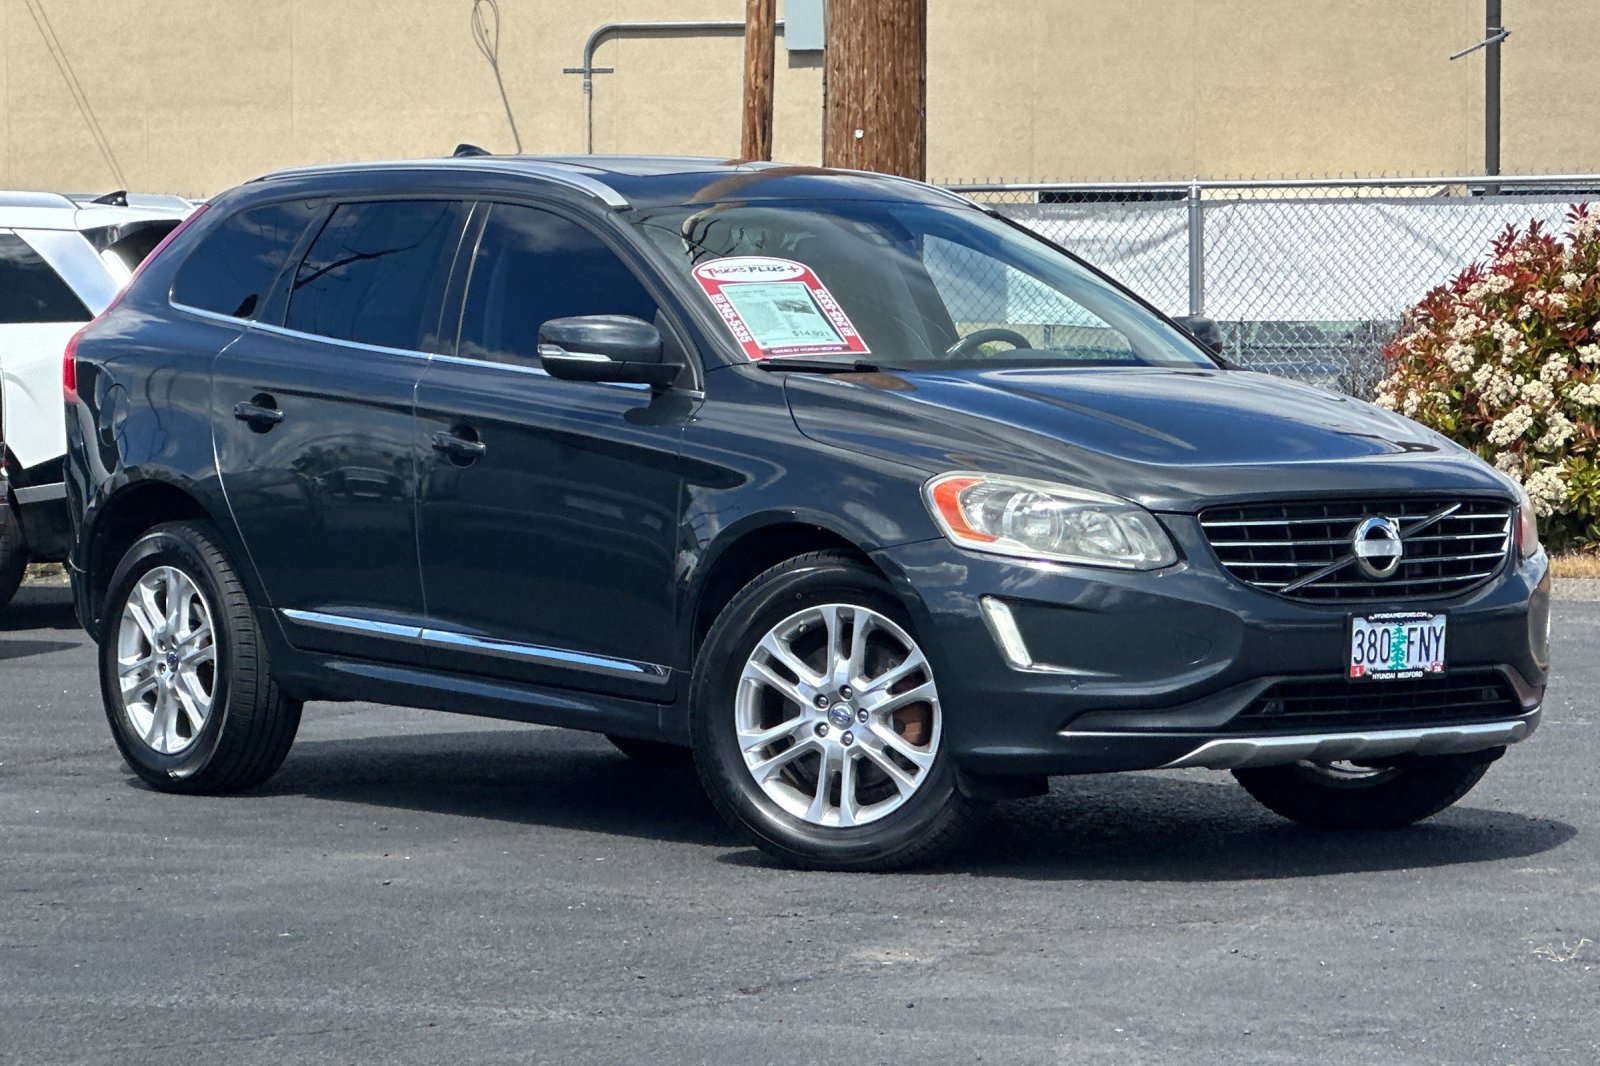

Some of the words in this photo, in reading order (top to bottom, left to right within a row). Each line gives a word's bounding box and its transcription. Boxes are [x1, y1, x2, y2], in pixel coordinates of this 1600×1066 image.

[1354, 628, 1391, 664] 380
[1406, 625, 1444, 663] FNY
[1372, 672, 1395, 680] HYUNDAI
[1397, 671, 1424, 679] MEDFORD
